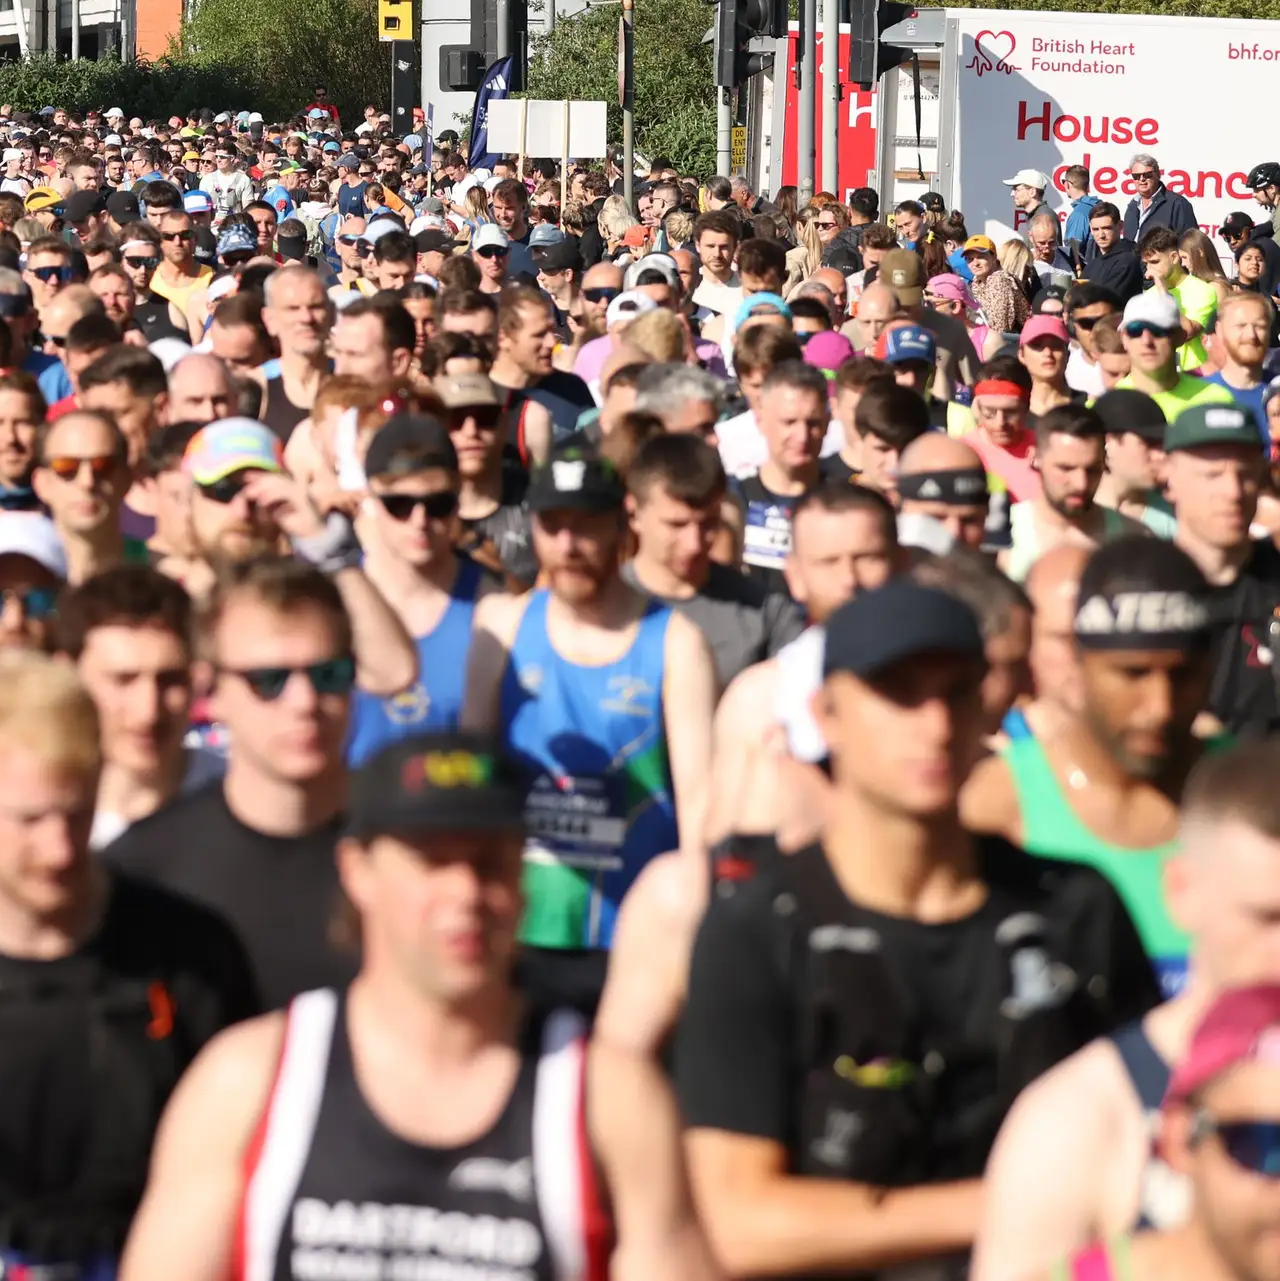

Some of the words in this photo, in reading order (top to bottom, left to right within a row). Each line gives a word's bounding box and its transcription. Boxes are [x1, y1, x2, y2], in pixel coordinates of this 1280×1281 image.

[1032, 38, 1085, 54] British
[1091, 40, 1135, 55] Heart
[1031, 57, 1125, 74] Foundation
[1017, 101, 1159, 145] House
